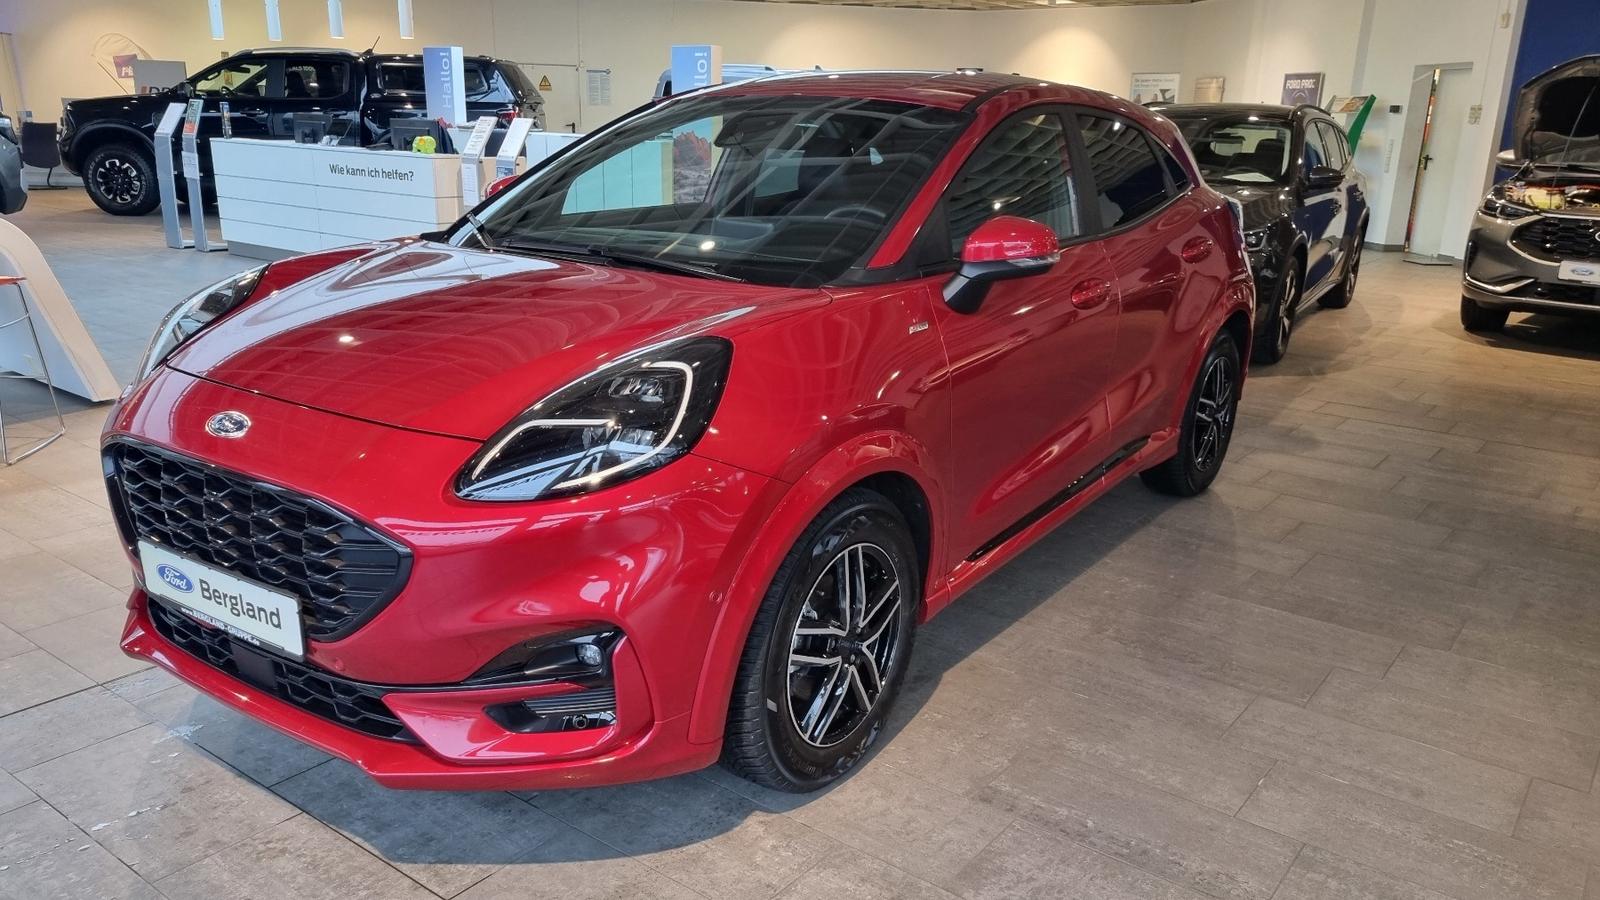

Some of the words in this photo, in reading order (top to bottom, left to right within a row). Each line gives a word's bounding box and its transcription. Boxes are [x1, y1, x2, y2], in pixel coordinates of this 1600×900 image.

[439, 51, 452, 108] Hallo!
[1285, 79, 1301, 89] FORD
[329, 163, 345, 174] Wie
[345, 165, 366, 177] kann
[367, 166, 380, 178] ich
[381, 168, 414, 181] helfen?
[160, 565, 190, 592] Ford
[198, 577, 283, 630] Bergland
